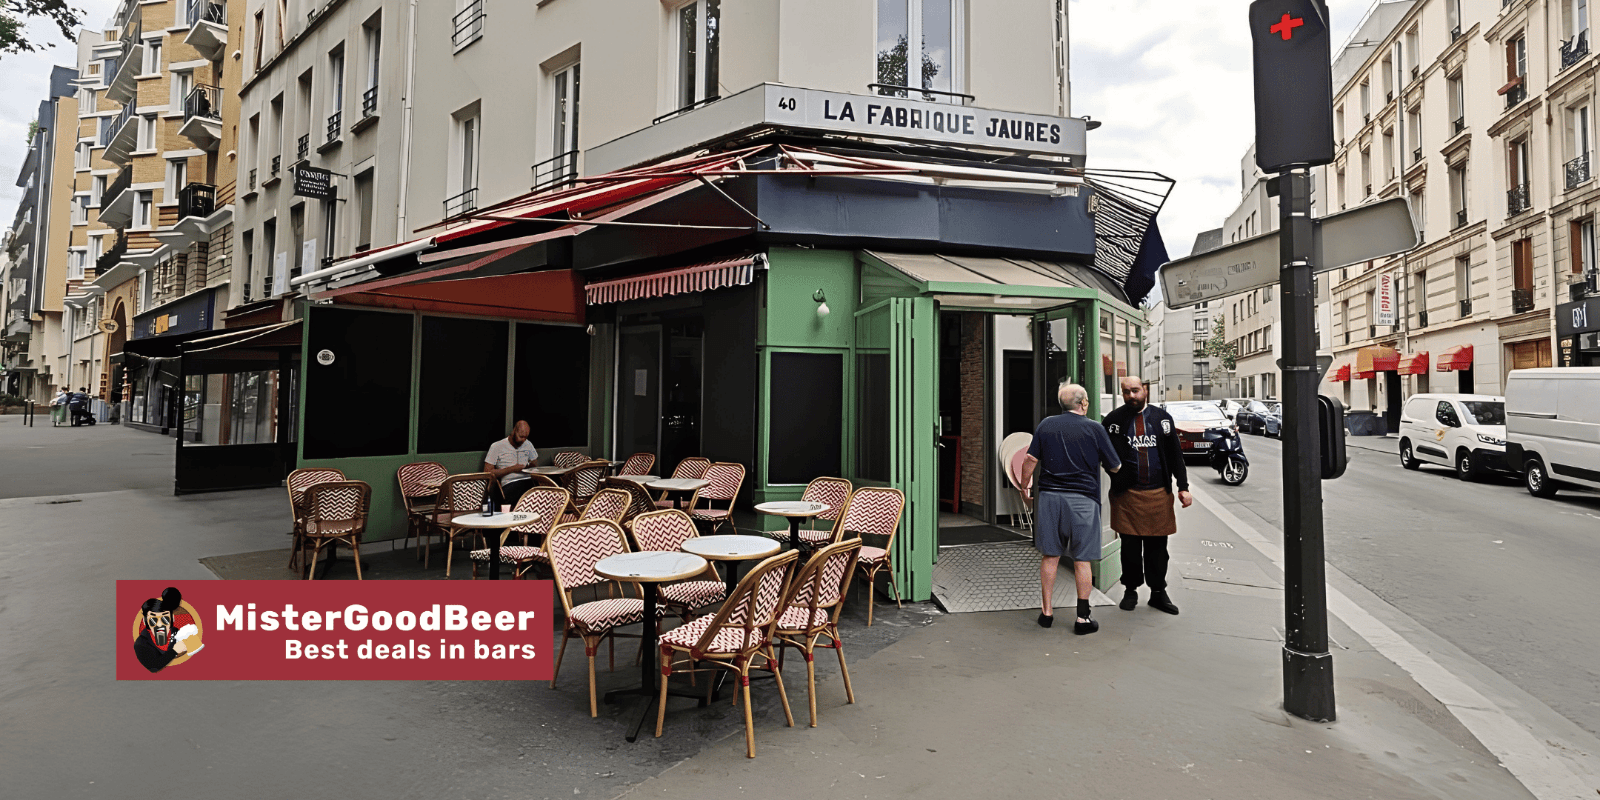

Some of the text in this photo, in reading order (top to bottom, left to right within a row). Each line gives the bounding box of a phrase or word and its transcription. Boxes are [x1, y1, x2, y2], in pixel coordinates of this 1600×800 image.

[778, 96, 797, 111] 40
[824, 99, 1061, 144] LA FABRIQUE JAURES
